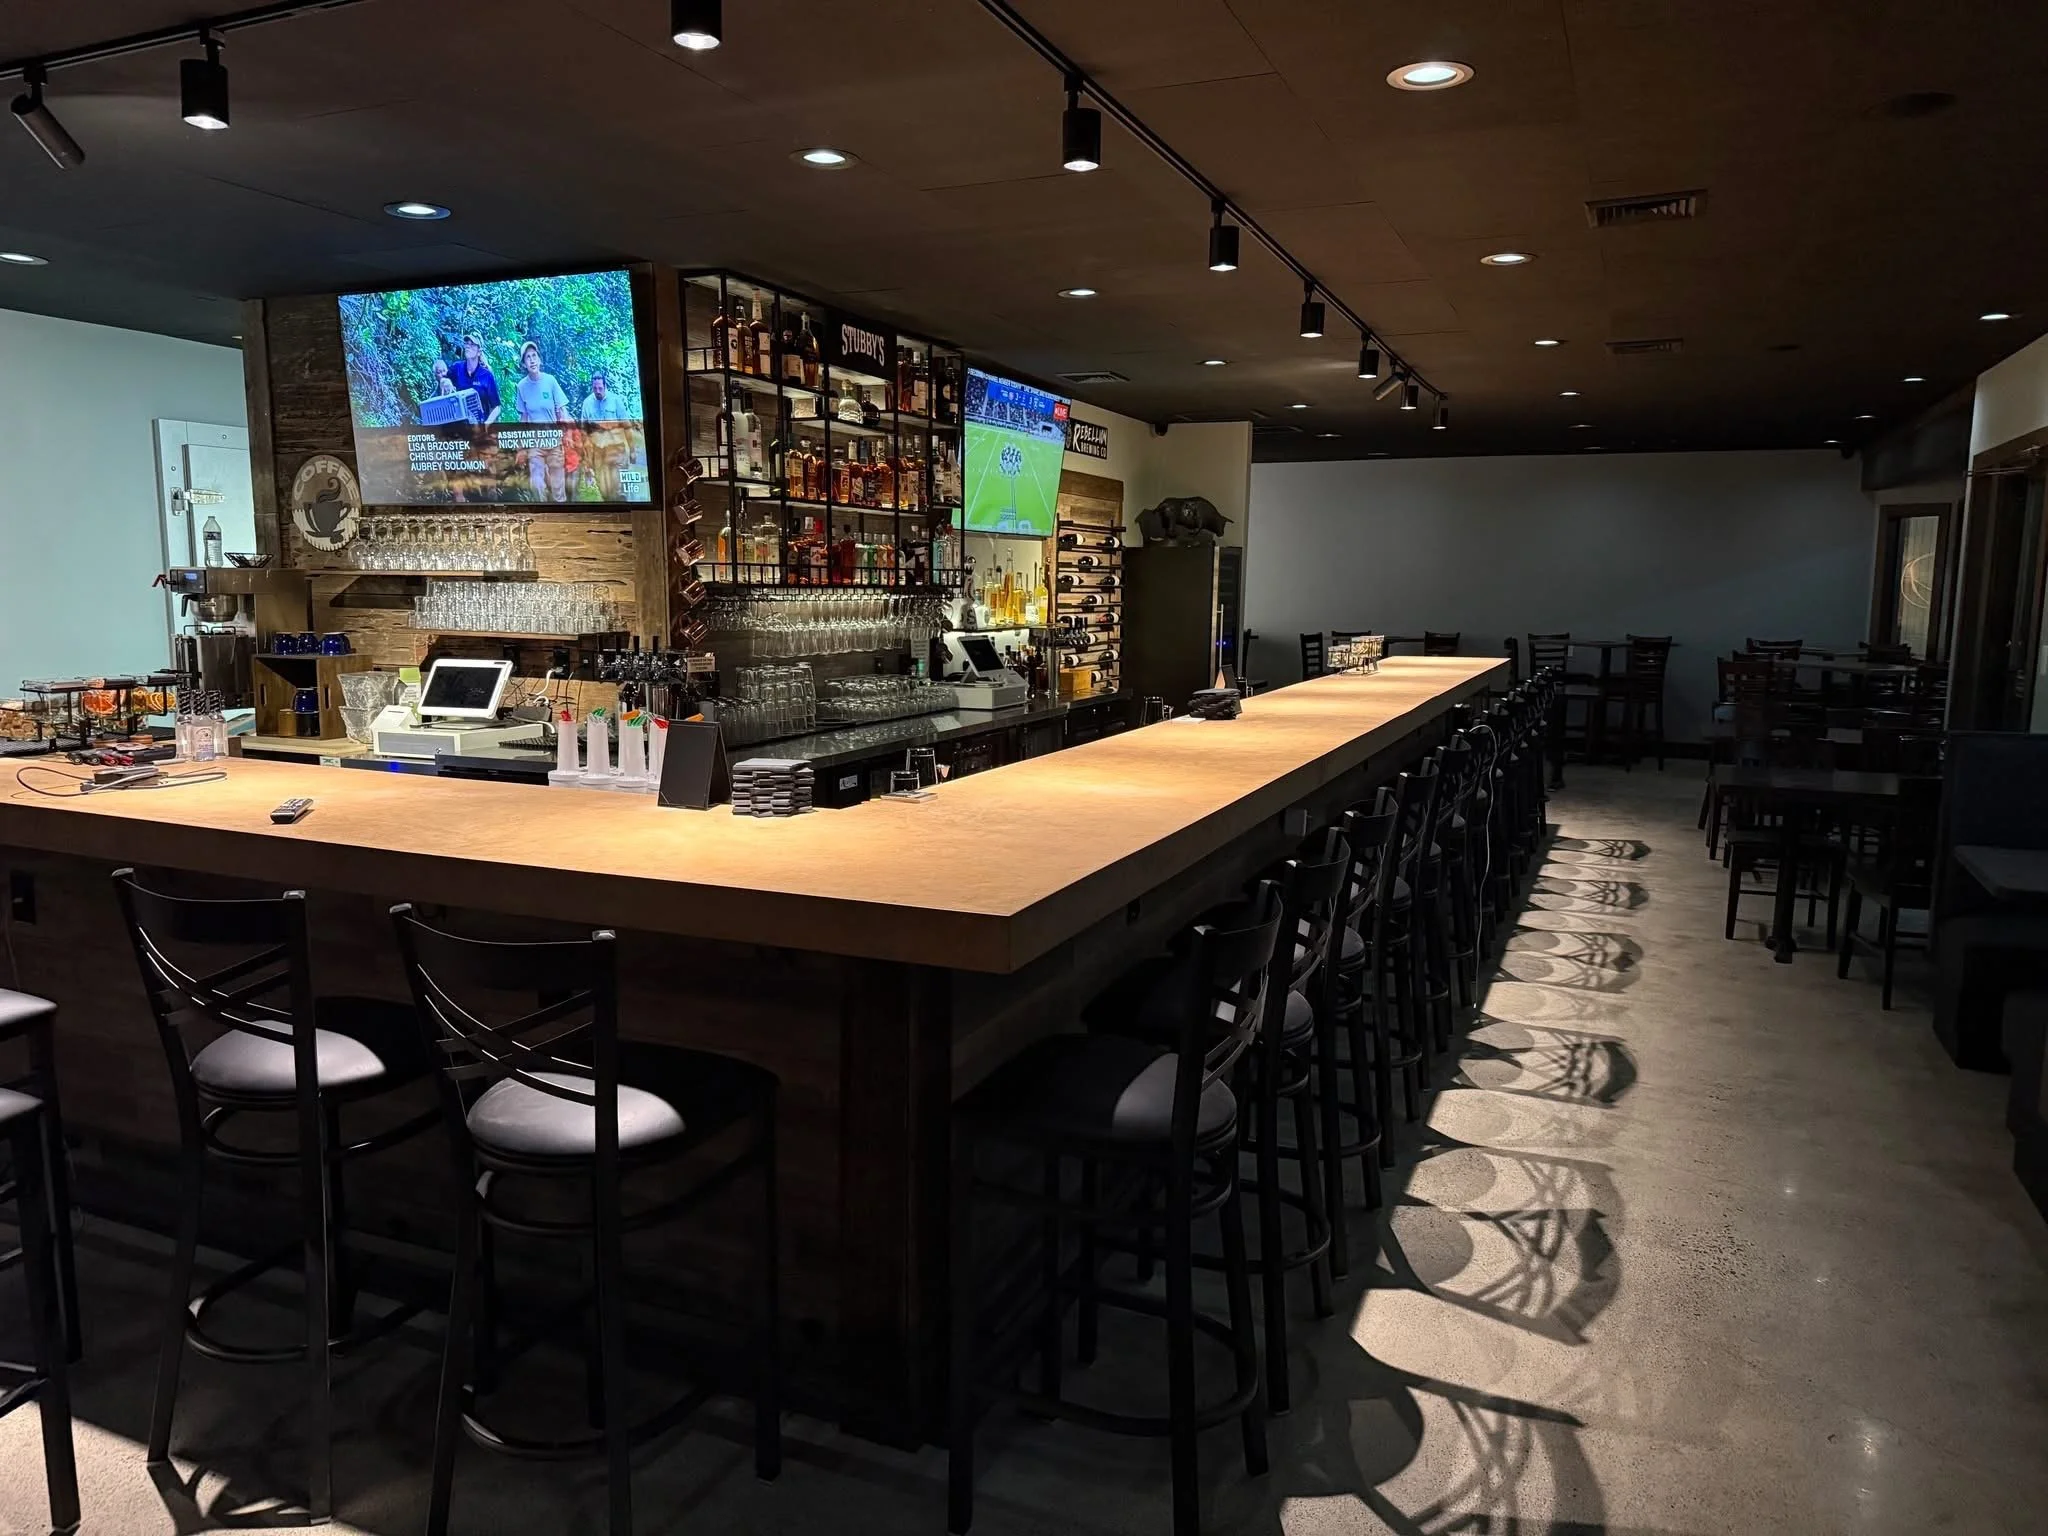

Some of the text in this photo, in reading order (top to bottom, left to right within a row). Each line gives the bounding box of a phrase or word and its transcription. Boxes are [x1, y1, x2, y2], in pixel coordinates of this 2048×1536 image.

[841, 323, 885, 367] STUBBY'S
[407, 434, 436, 442] EDITORS
[498, 430, 563, 439] ASSISTANT EDITOR
[1072, 423, 1107, 452] REBELLION
[408, 441, 471, 452] LISA BRZOSTEK
[498, 438, 558, 449] NICK WEYAND
[409, 451, 464, 461] CHRIS CRANE
[411, 461, 486, 471] AUBREY SOLOMON
[294, 460, 360, 501] COFFEE
[621, 473, 640, 481] WILD
